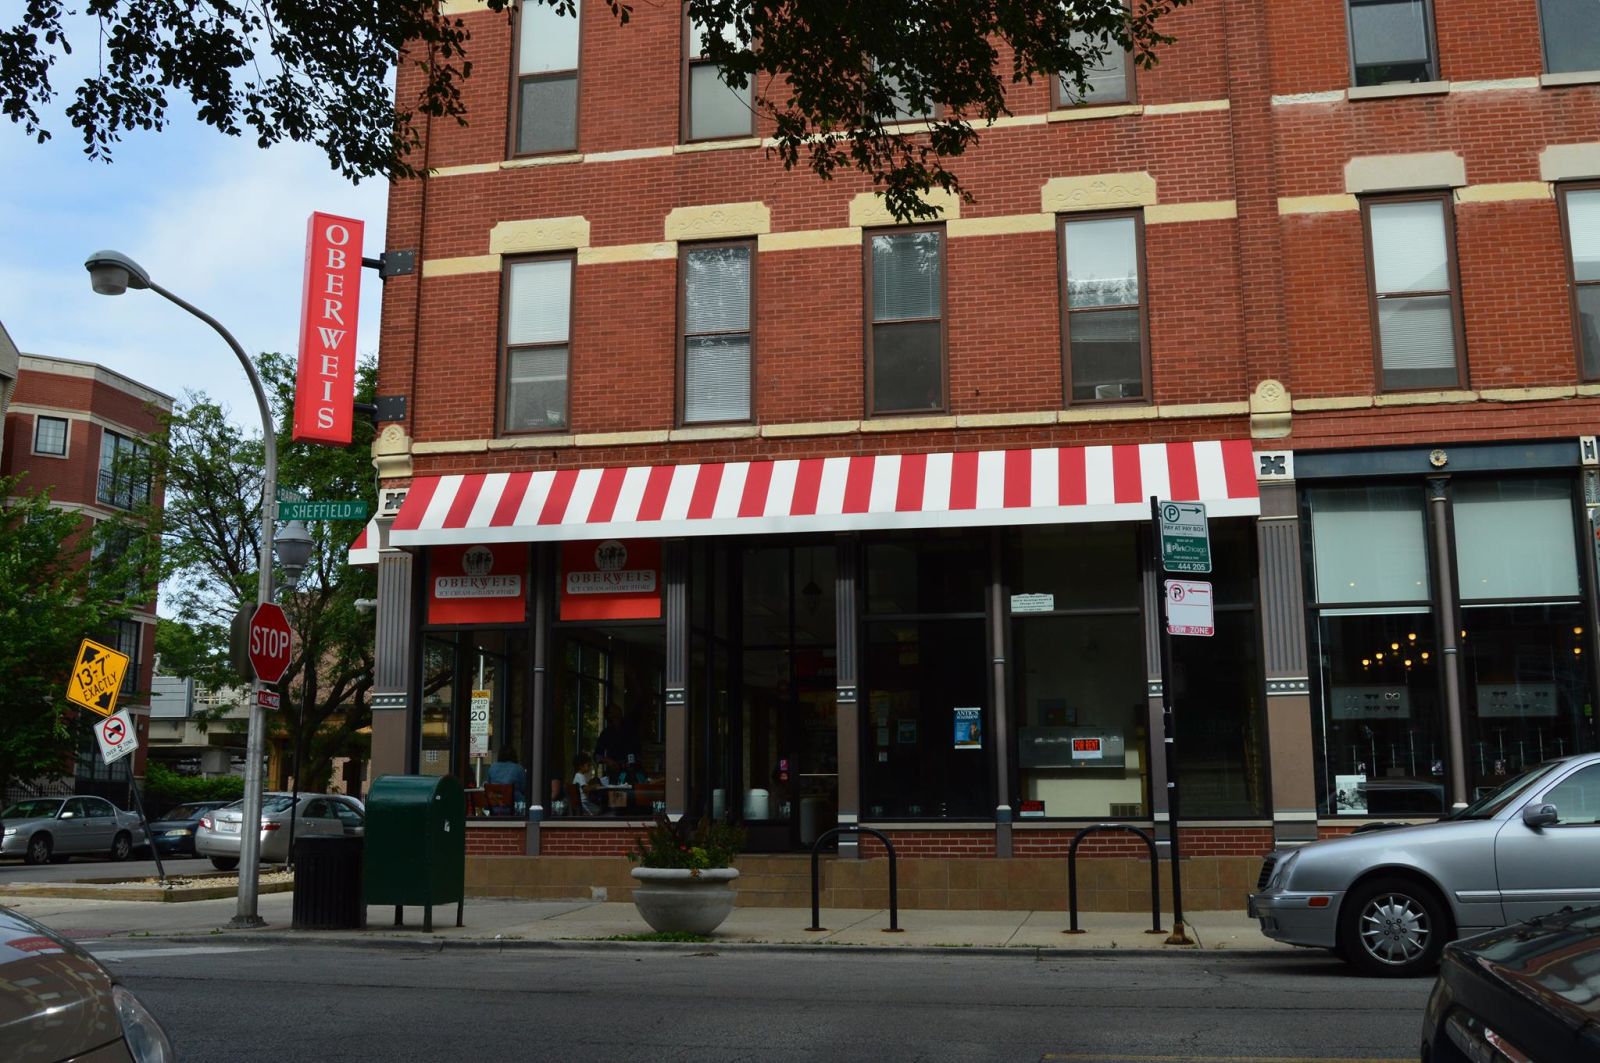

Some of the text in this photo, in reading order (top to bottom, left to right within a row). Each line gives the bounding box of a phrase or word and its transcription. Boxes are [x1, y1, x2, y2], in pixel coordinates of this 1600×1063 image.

[317, 224, 349, 429] OBERWEIS
[284, 503, 363, 518] N SHEFFIELD AV
[1192, 563, 1206, 571] 205
[438, 576, 516, 589] OBERWEIS
[569, 572, 651, 585] OBERWEIS
[1170, 625, 1186, 633] TOW
[252, 625, 289, 659] STOP
[83, 672, 117, 702] EXACTLY
[471, 711, 487, 720] 20
